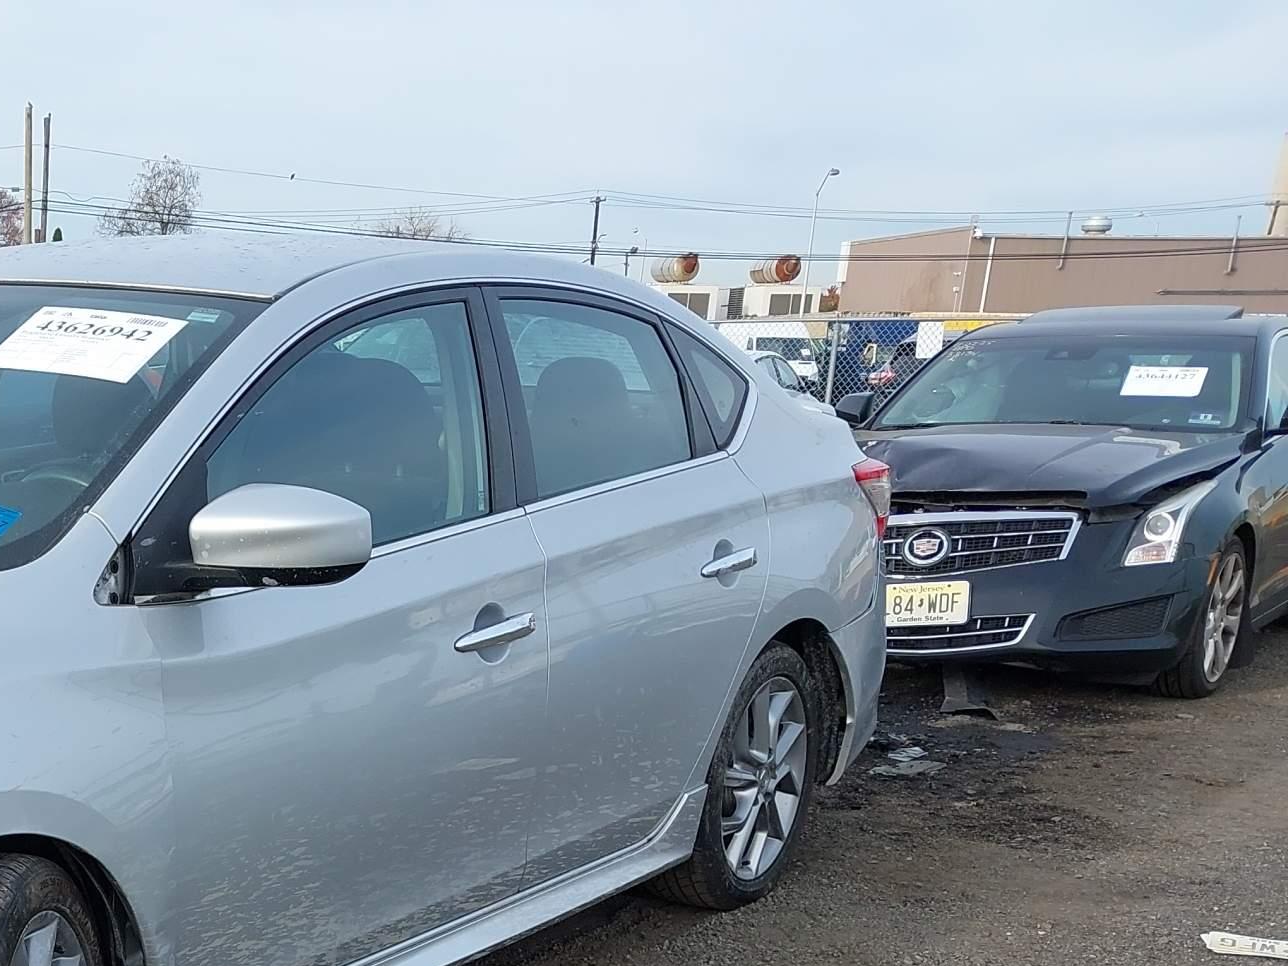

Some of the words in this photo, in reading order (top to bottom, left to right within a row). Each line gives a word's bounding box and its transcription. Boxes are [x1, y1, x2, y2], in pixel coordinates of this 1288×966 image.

[36, 319, 153, 342] 43626942
[886, 595, 914, 616] 84
[928, 592, 962, 613] WDF
